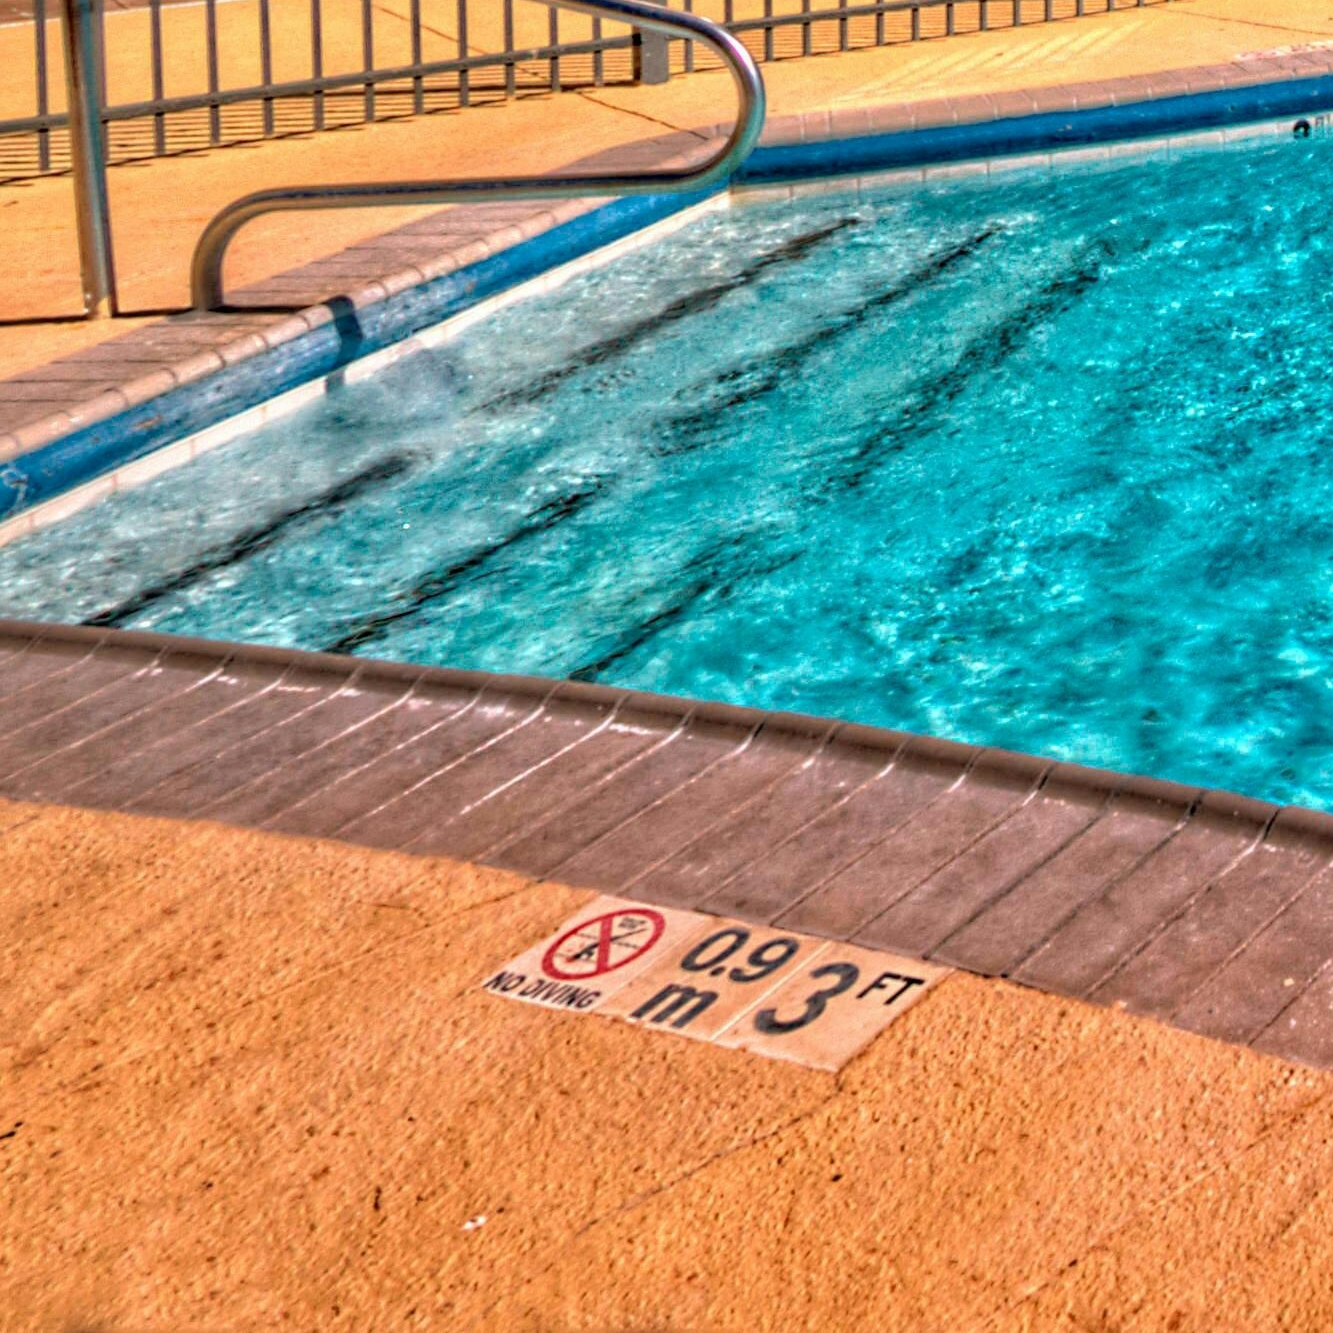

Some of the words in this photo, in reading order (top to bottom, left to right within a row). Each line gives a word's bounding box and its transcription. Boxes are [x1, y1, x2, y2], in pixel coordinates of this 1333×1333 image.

[483, 971, 526, 992] NO
[518, 979, 601, 1008] DIVING
[680, 927, 800, 984] 0.9
[754, 962, 860, 1035] 3
[856, 971, 925, 1006] FT
[630, 983, 719, 1029] m
